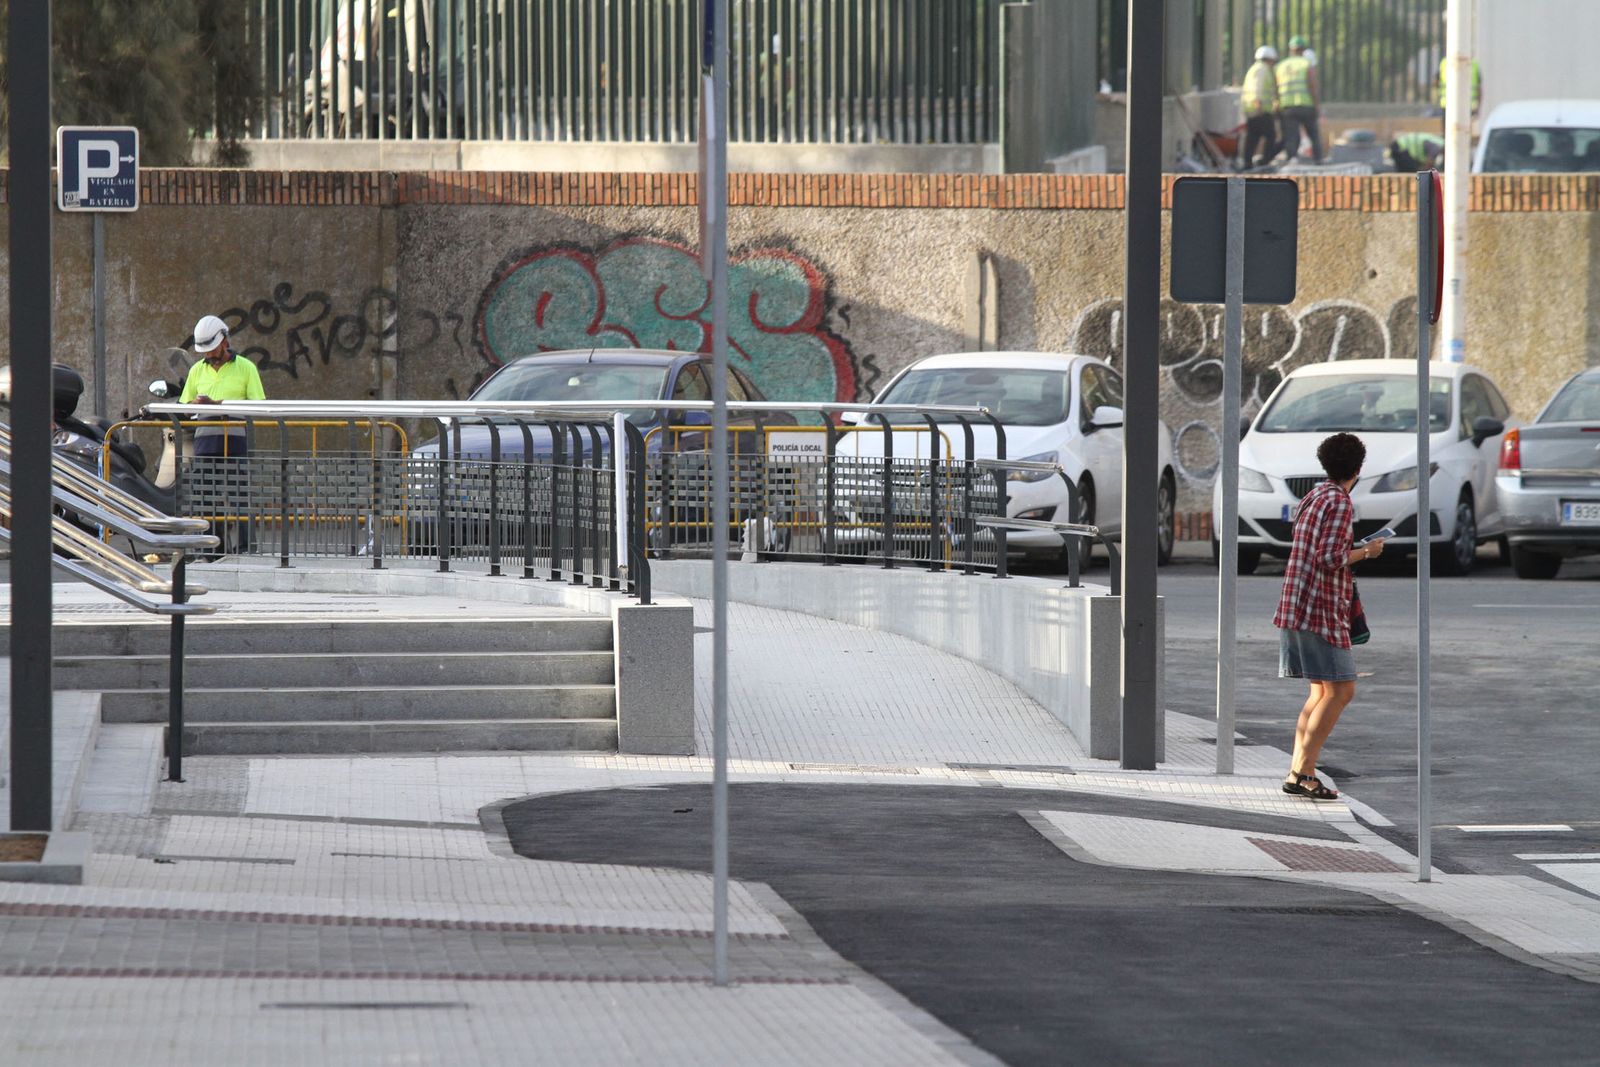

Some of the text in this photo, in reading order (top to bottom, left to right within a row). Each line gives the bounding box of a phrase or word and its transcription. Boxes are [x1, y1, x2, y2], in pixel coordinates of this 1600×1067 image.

[78, 140, 119, 199] P
[90, 178, 135, 186] VIGILADO
[103, 188, 115, 196] EN
[89, 198, 130, 206] BATERIA
[772, 443, 799, 451] POLICÍA
[1574, 505, 1600, 519] 839
